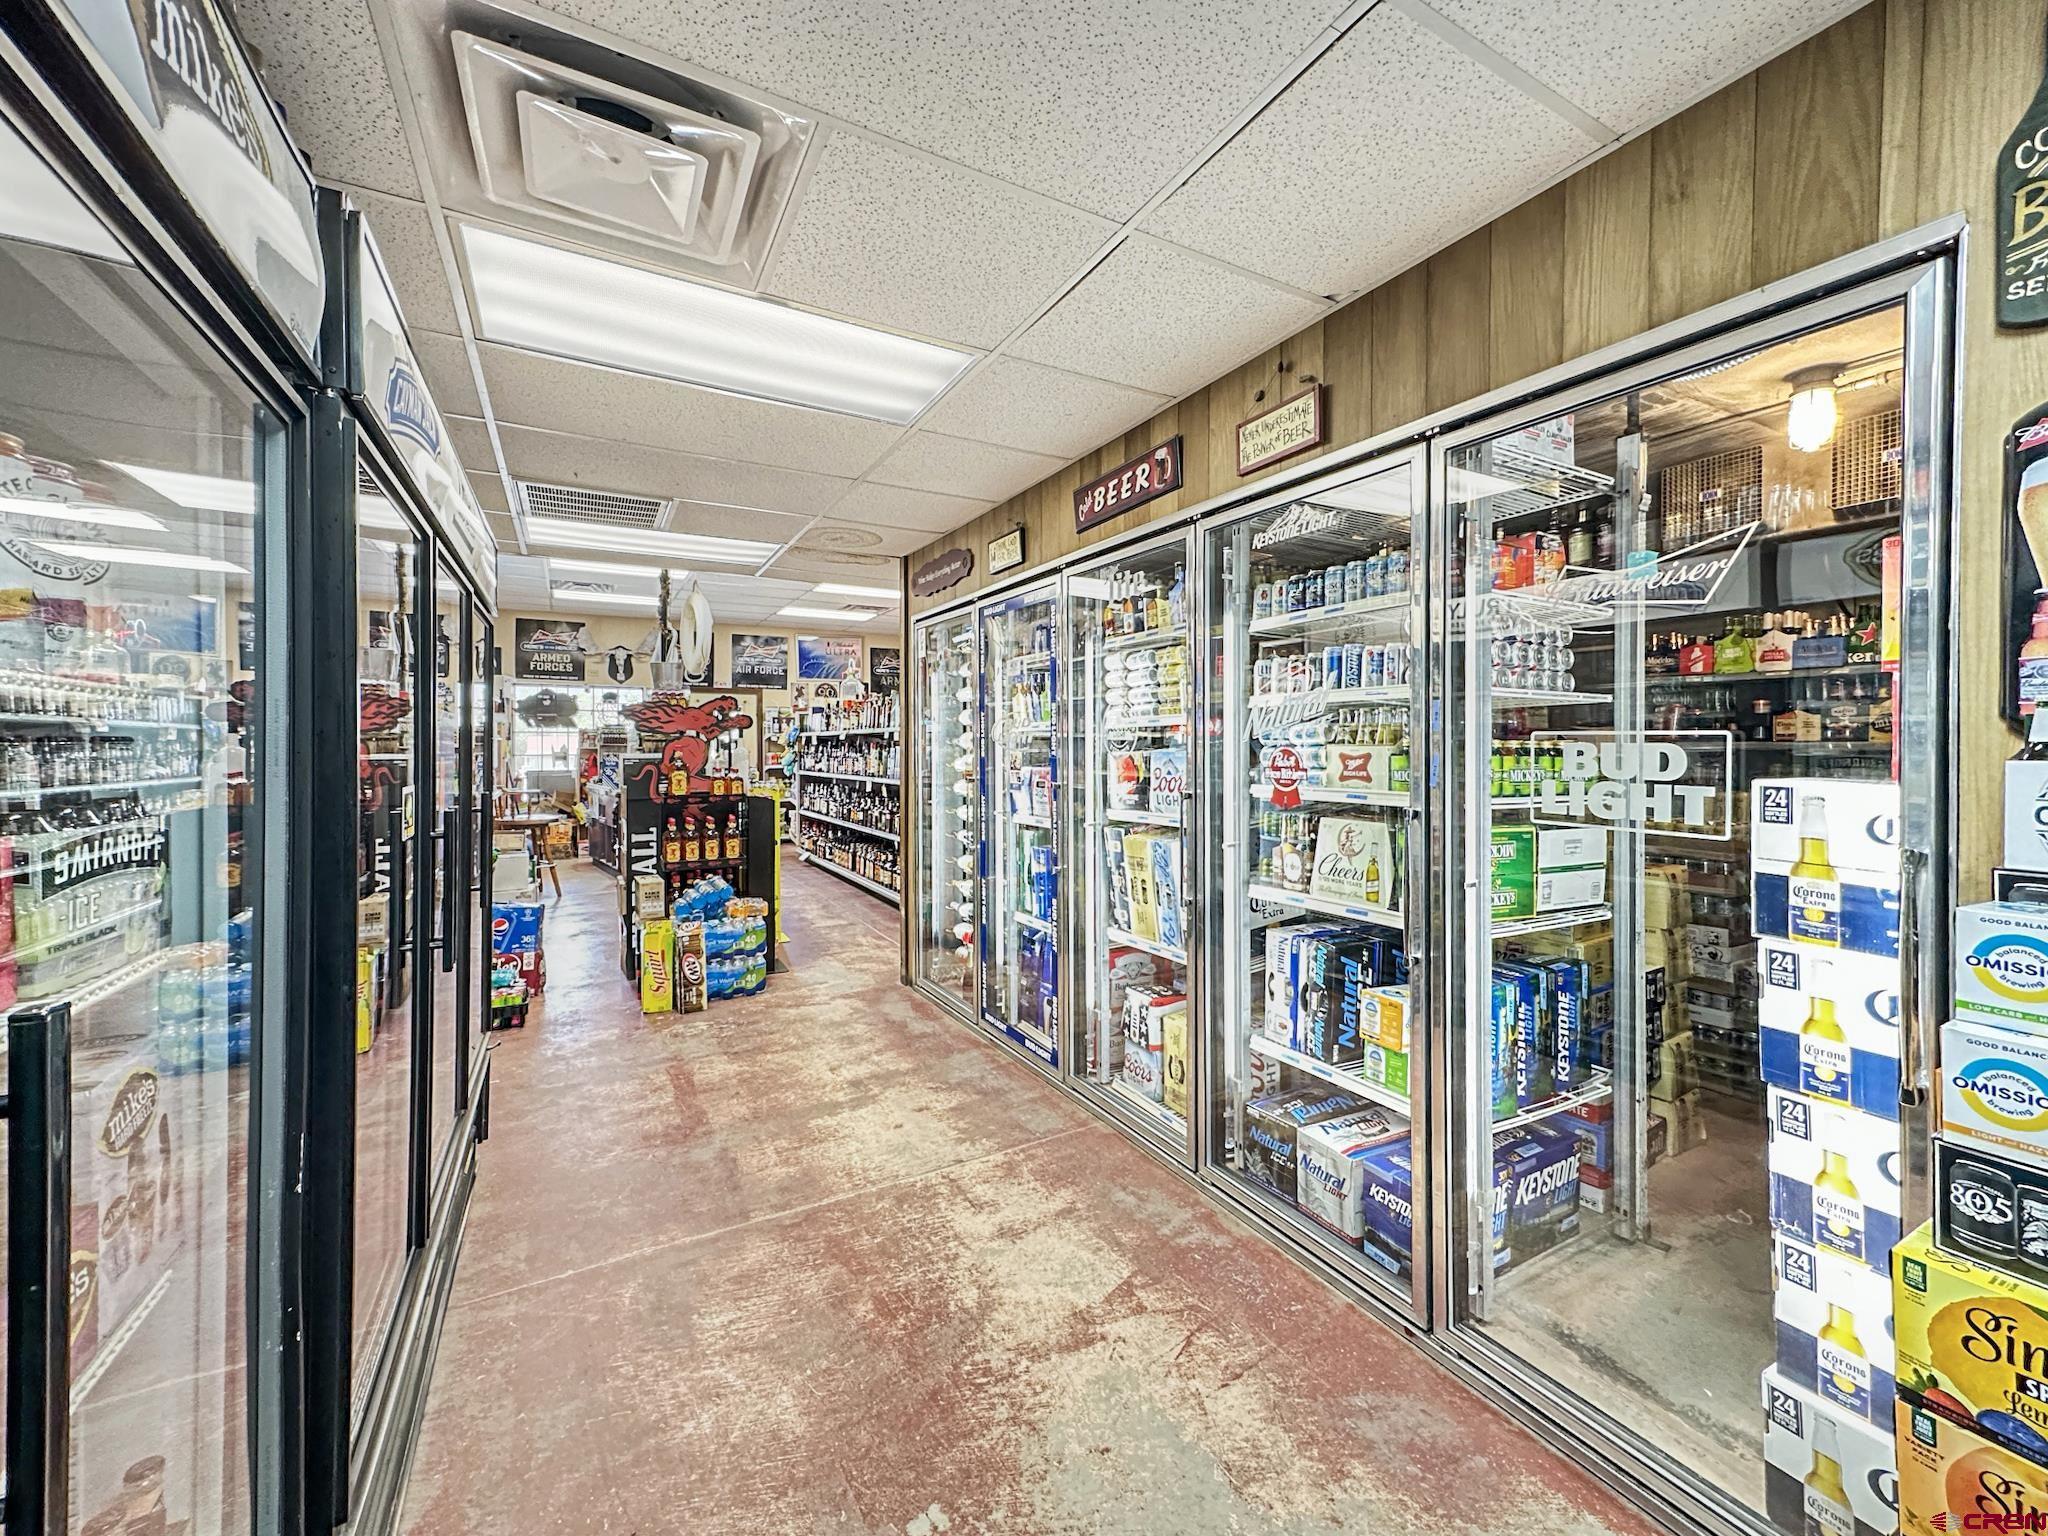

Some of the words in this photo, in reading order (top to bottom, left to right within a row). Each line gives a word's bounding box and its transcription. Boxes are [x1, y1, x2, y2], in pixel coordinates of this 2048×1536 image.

[1282, 421, 1312, 446] BEER
[1093, 463, 1151, 513] BEER
[1252, 525, 1302, 550] KEYSTONE
[1301, 510, 1338, 534] LIGHT
[530, 661, 573, 672] FORCES
[532, 652, 571, 663] ARMED
[736, 663, 752, 674] AIR
[753, 665, 785, 676] FORCE
[1563, 742, 1688, 782] BUD
[1541, 780, 1716, 826] LIGHT
[1765, 788, 1788, 807] 24
[53, 832, 166, 886] SMIRNOFF
[1318, 852, 1365, 882] Cheers
[1793, 885, 1836, 901] Corona
[1803, 897, 1827, 908] Extra
[67, 893, 101, 932] ICE
[1262, 907, 1284, 920] Extra
[1979, 917, 2012, 926] GOOD
[48, 938, 84, 955] TRIPLE
[84, 923, 118, 943] BLACK
[646, 949, 671, 994] Squirt
[1770, 952, 1795, 973] 24
[1965, 955, 2048, 978] OMISSI
[1999, 974, 2045, 989] brewing
[1338, 955, 1358, 1049] Natural
[1968, 1003, 1991, 1013] LOW
[1994, 1007, 2023, 1019] CARB
[1557, 990, 1570, 1082] KEYSTONE
[1966, 1038, 1999, 1050] GOOD
[1803, 1042, 1847, 1063] Corona
[1983, 1072, 2038, 1092] balanced
[107, 1078, 156, 1142] mike's
[1781, 1099, 1806, 1122] 24
[1987, 1099, 2034, 1117] brewing
[1319, 1109, 1387, 1136] Natural
[1356, 1117, 1391, 1132] LIGHT
[1249, 1125, 1293, 1156] Natural
[1971, 1129, 2003, 1144] LIGHT
[1300, 1153, 1346, 1190] Natural
[1514, 1152, 1581, 1206] KEYSTONE
[1323, 1182, 1348, 1201] LIGHT
[1368, 1182, 1412, 1217] KEYSTO
[1554, 1179, 1578, 1205] LIGHT
[1950, 1182, 2013, 1222] 805
[1817, 1194, 1860, 1220] Corona
[1785, 1249, 1811, 1273] 24
[1821, 1347, 1867, 1378] Corona
[1772, 1390, 1796, 1417] 24
[1904, 1435, 1945, 1461] VARIETY
[1911, 1446, 1937, 1463] PACK
[1807, 1495, 1852, 1531] Corona
